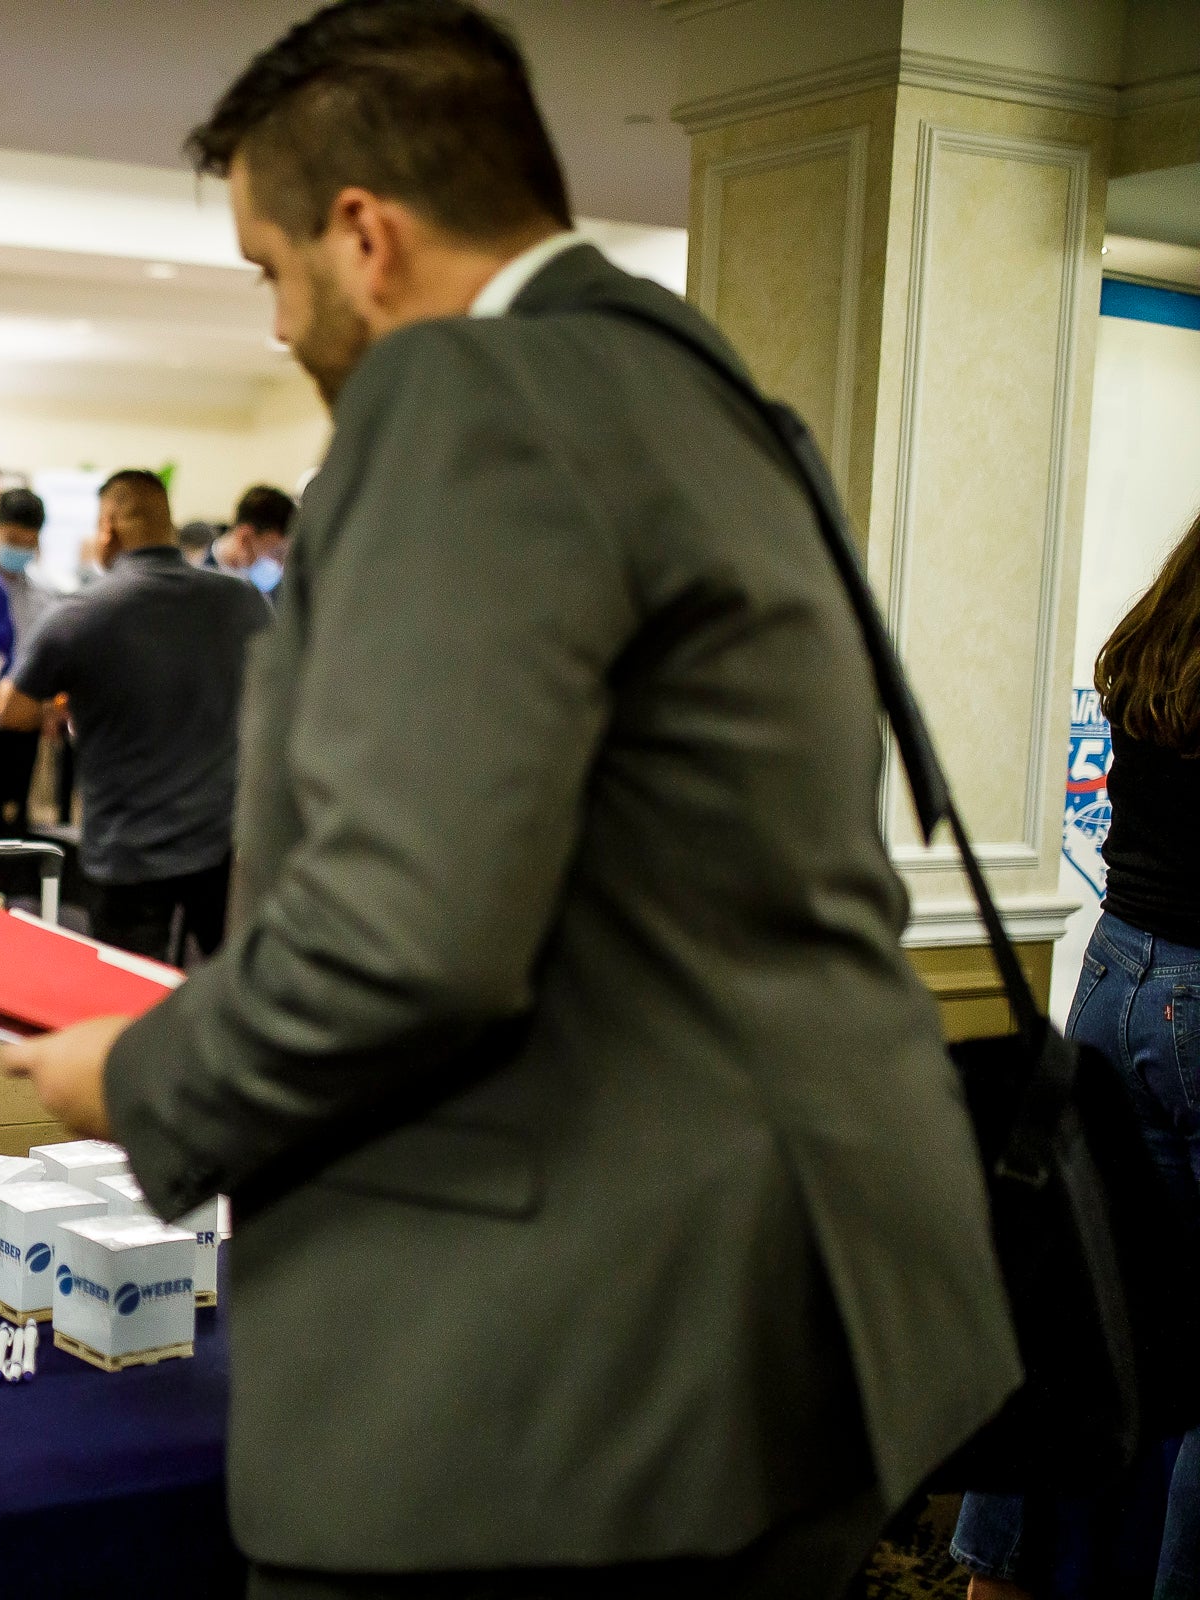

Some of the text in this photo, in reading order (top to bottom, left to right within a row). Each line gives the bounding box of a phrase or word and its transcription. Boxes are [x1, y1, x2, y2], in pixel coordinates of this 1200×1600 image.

[1071, 740, 1113, 780] 5
[74, 1275, 109, 1303] WEBER
[141, 1278, 193, 1300] WEBER
